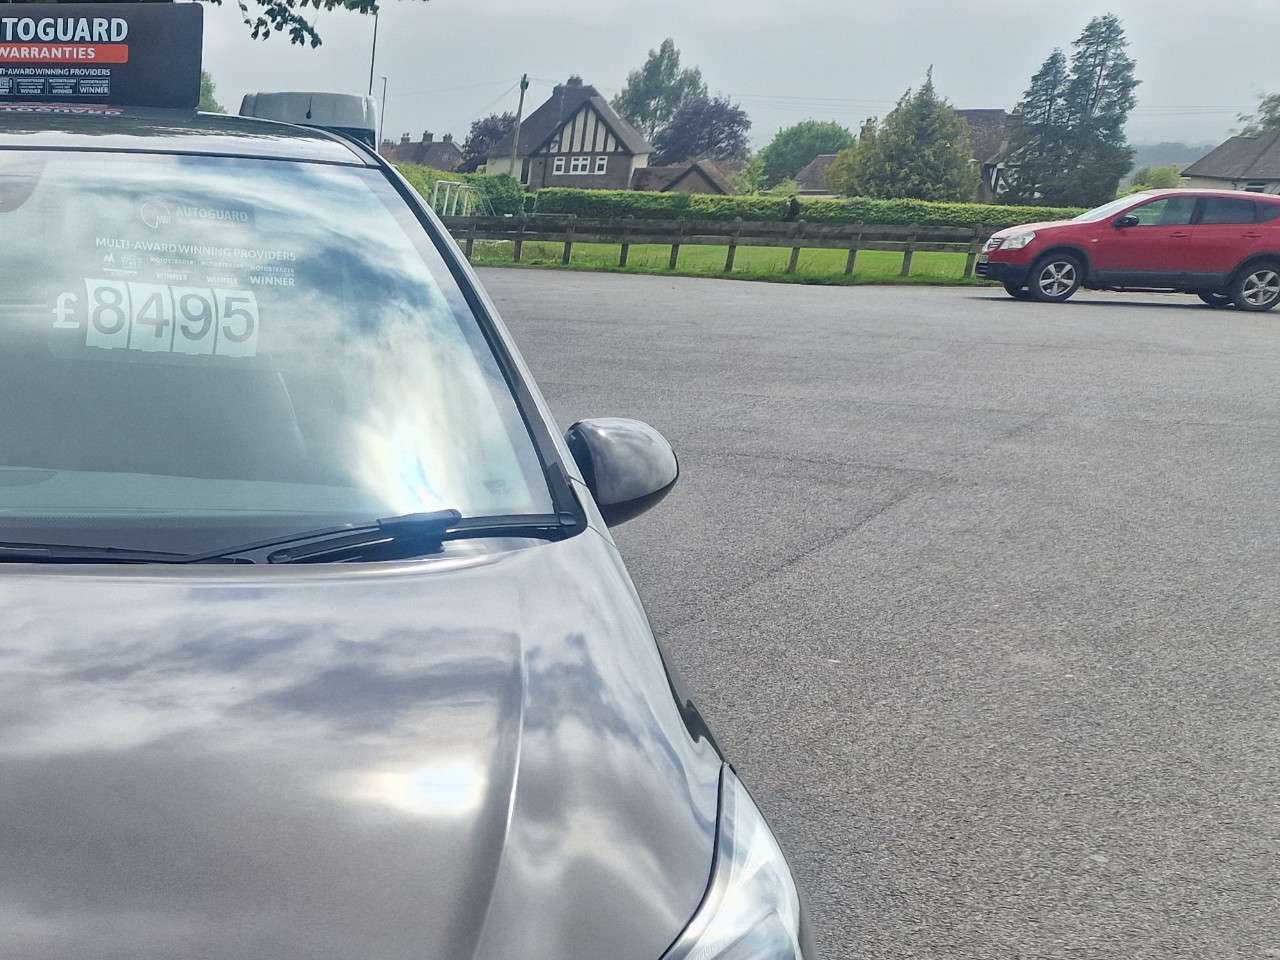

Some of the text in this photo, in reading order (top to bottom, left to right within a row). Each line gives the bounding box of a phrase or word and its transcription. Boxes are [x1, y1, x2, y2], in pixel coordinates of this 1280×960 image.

[70, 68, 111, 76] PROVIDERS
[80, 86, 109, 94] WINNER
[176, 204, 249, 222] AUTOGUARD
[233, 248, 296, 262] PROVIDERS
[249, 275, 296, 287] WINNER
